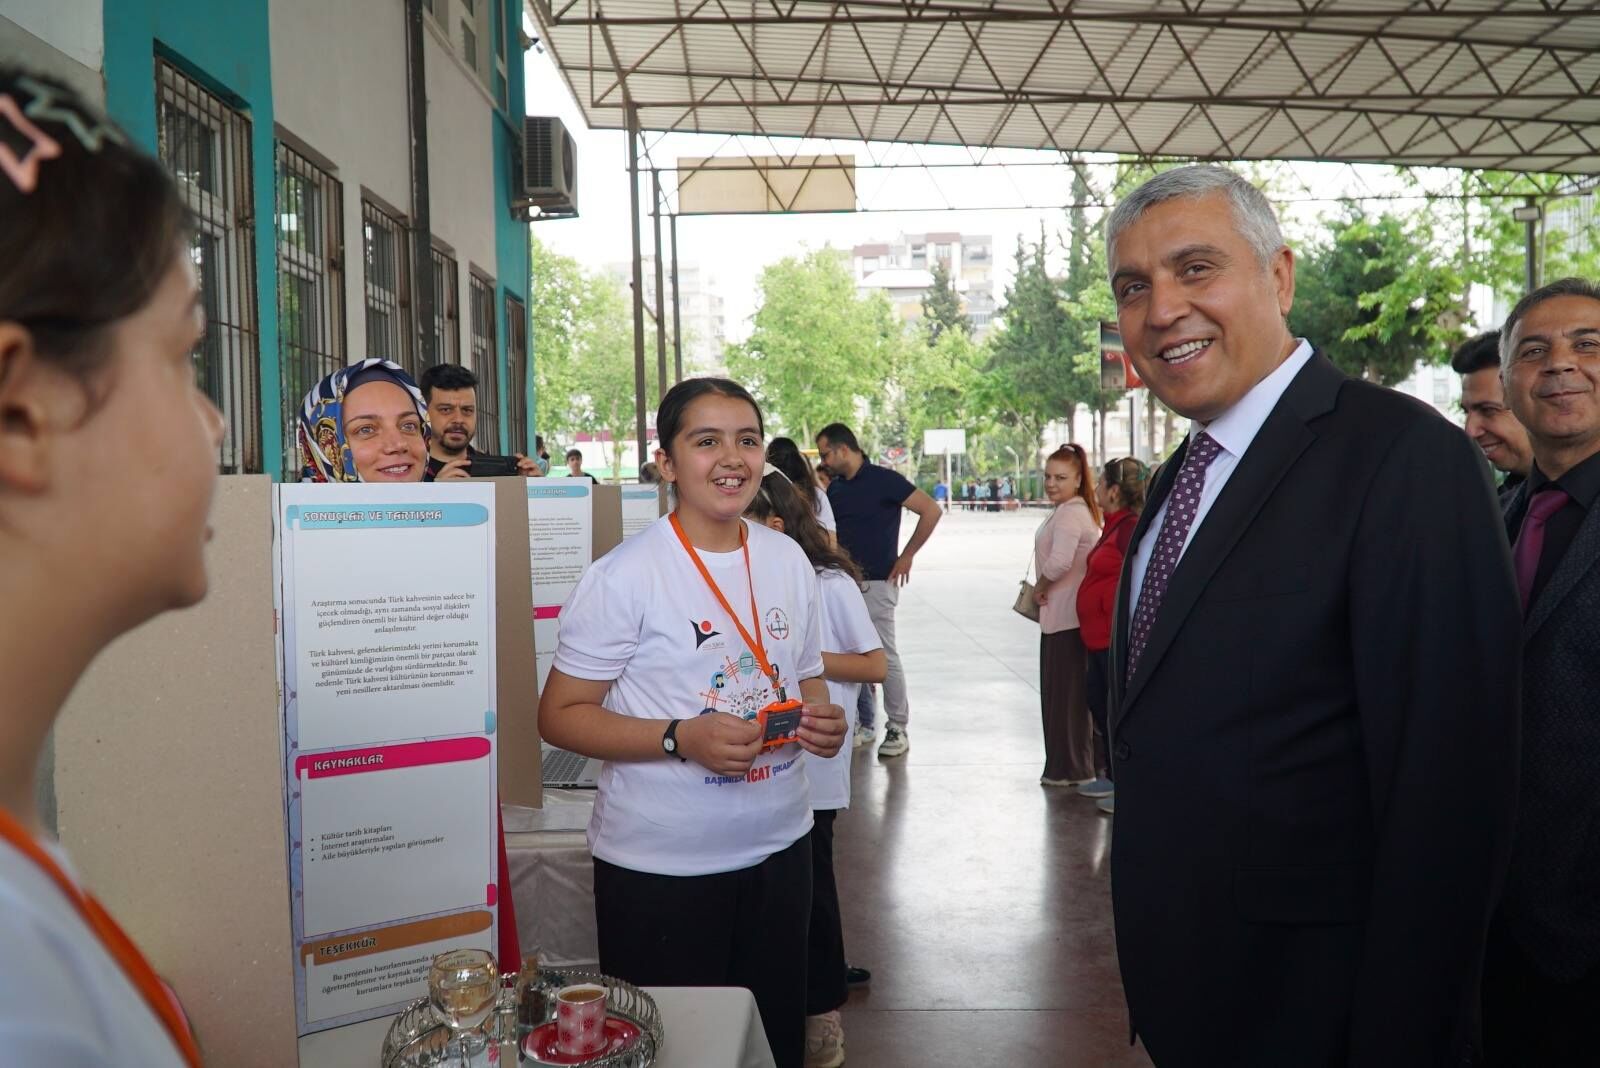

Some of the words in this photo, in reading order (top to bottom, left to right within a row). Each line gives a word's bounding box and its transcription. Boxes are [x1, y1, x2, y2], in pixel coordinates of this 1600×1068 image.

[303, 511, 365, 524] SONUÇLAR
[367, 511, 382, 520] VE
[386, 510, 442, 523] TARTIŞMA
[311, 600, 346, 608] Araştırma
[349, 597, 386, 605] sonucunda
[317, 609, 338, 617] içecek
[340, 607, 372, 615] olmadığı,
[374, 606, 390, 614] aynı
[391, 605, 421, 613] zamanda
[422, 604, 442, 612] sosyal
[444, 602, 470, 611] ilişkileri
[318, 618, 360, 628] güçlendiren
[362, 616, 386, 624] önemli
[399, 614, 425, 622] kültürel
[426, 614, 445, 622] değer
[446, 612, 469, 620] olduğu
[374, 625, 416, 634] anlaşılmıştır.
[357, 644, 421, 656] geleneklerimizdeki
[422, 642, 442, 650] yerini
[443, 640, 478, 648] korumakta
[350, 656, 394, 665] kimliğimizin
[432, 651, 455, 660] parçası
[321, 668, 363, 678] günümüzde
[375, 664, 403, 673] varlığını
[404, 662, 457, 670] sürdürmektedir.
[315, 679, 343, 687] nedenle
[363, 676, 388, 684] kahvesi
[390, 672, 428, 681] kültürünün
[430, 670, 465, 678] korunması
[336, 688, 350, 697] yeni
[352, 685, 382, 694] nesillere
[383, 682, 420, 692] aktarılması
[421, 680, 455, 688] önemlidir.
[314, 754, 384, 770] KAYNAKLAR
[321, 832, 344, 841] Kültür
[345, 829, 362, 837] tarih
[363, 825, 392, 836] kitapları
[351, 834, 394, 847] araştırmaları
[322, 852, 336, 861] Aile
[337, 847, 380, 859] büyükleriyle
[381, 842, 406, 853] yapılan
[407, 835, 444, 849] görüşmeler
[320, 938, 376, 956] TEŞEKKÜR
[344, 968, 373, 981] projenin
[374, 955, 428, 972] hazırlanmasında
[322, 977, 377, 994] öğretmenlerime
[388, 968, 411, 979] kaynak
[356, 984, 392, 995] kurumlara
[394, 977, 421, 988] teşekkür
